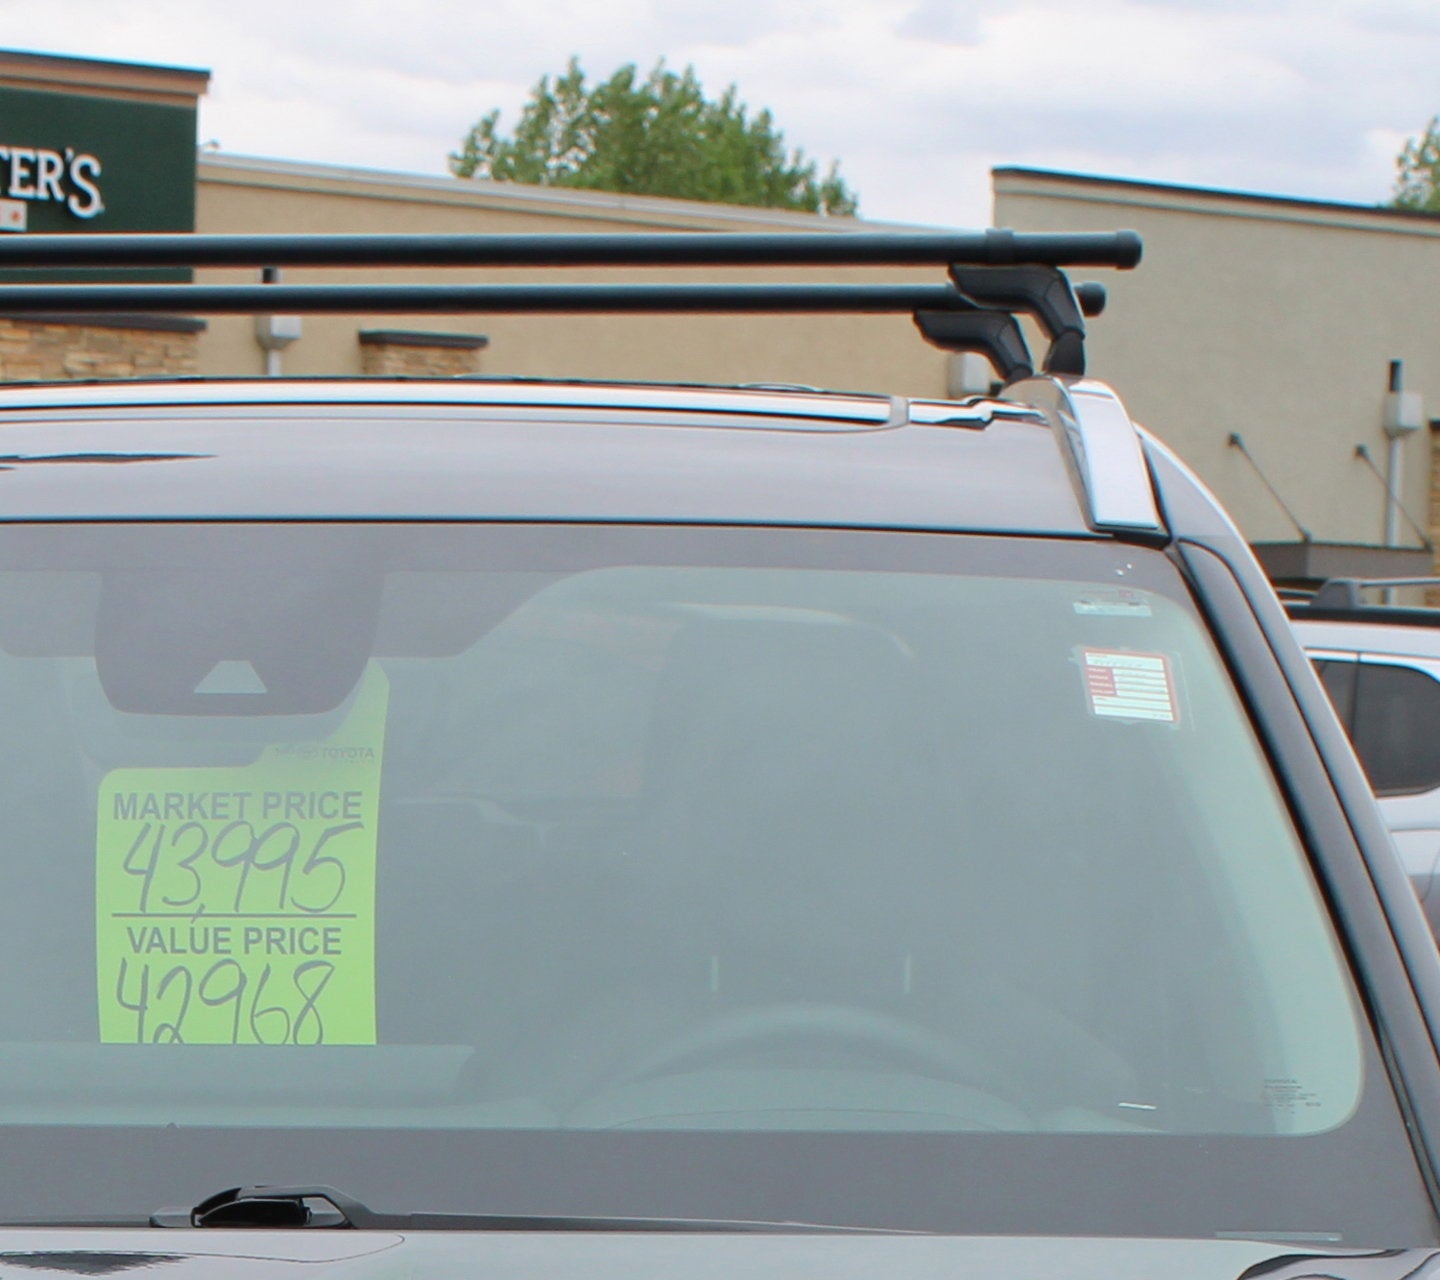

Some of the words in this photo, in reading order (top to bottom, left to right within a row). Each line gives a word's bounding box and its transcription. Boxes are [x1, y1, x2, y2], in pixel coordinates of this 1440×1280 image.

[113, 792, 251, 820] MARKET
[262, 791, 363, 820] PRICE
[127, 927, 231, 955] VALUE
[244, 926, 342, 955] PRICE
